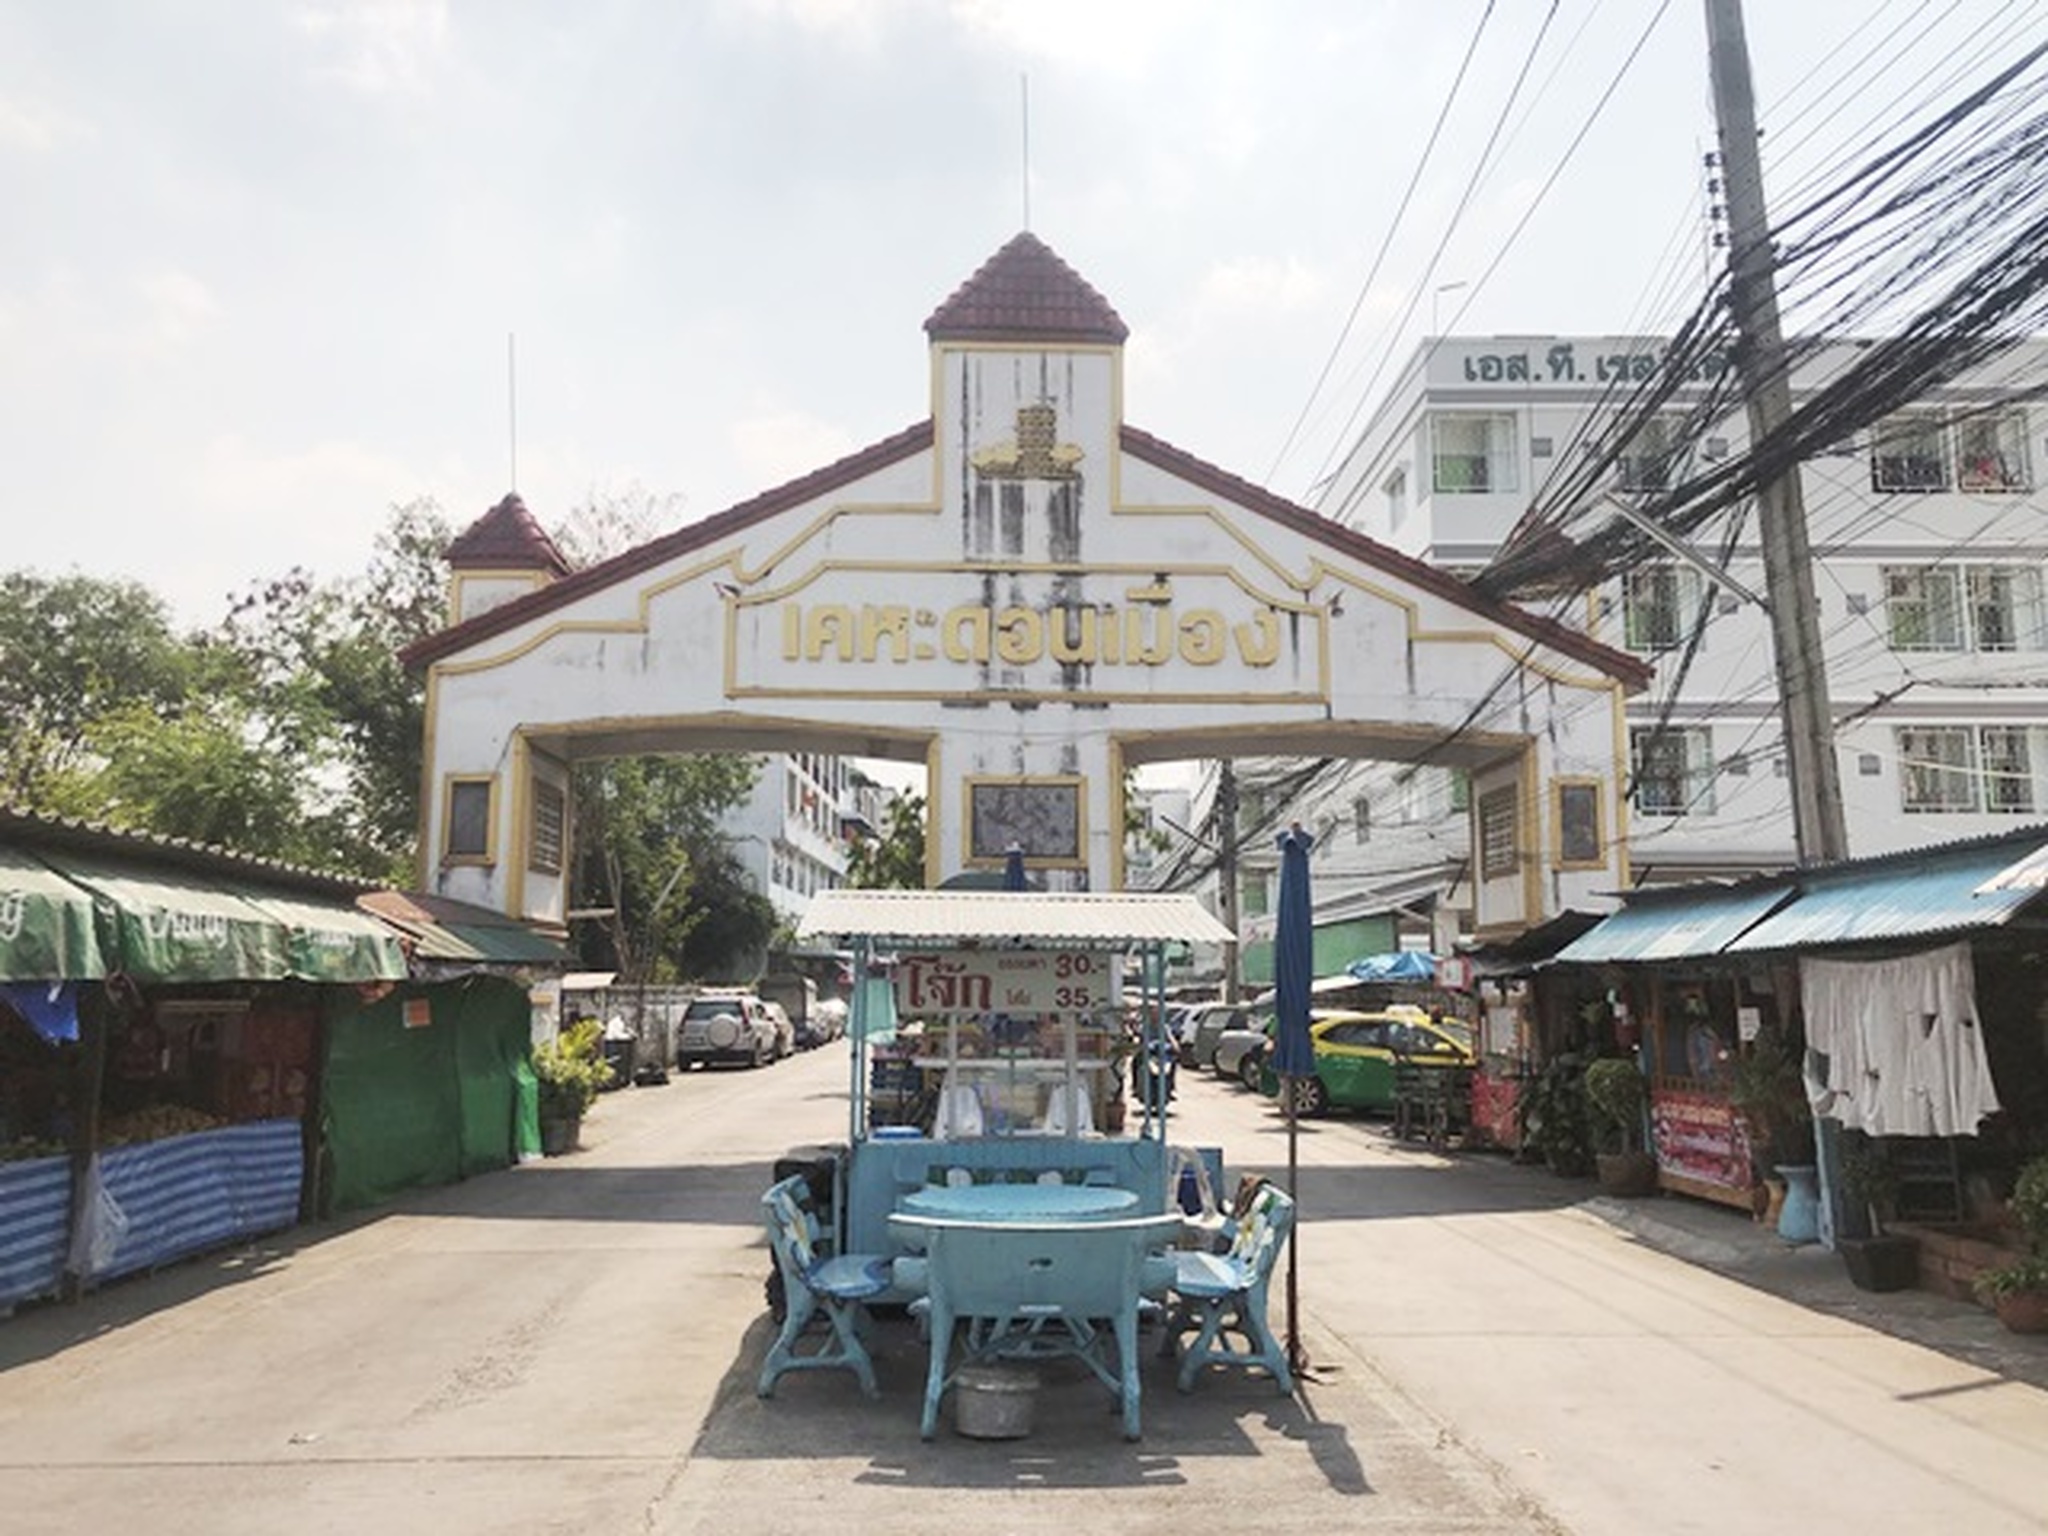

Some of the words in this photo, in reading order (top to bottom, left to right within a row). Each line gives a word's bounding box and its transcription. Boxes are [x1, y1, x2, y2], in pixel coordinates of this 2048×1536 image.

[780, 583, 1281, 667] เคหะดอนเมือง
[901, 955, 992, 1011] โจ๊ก
